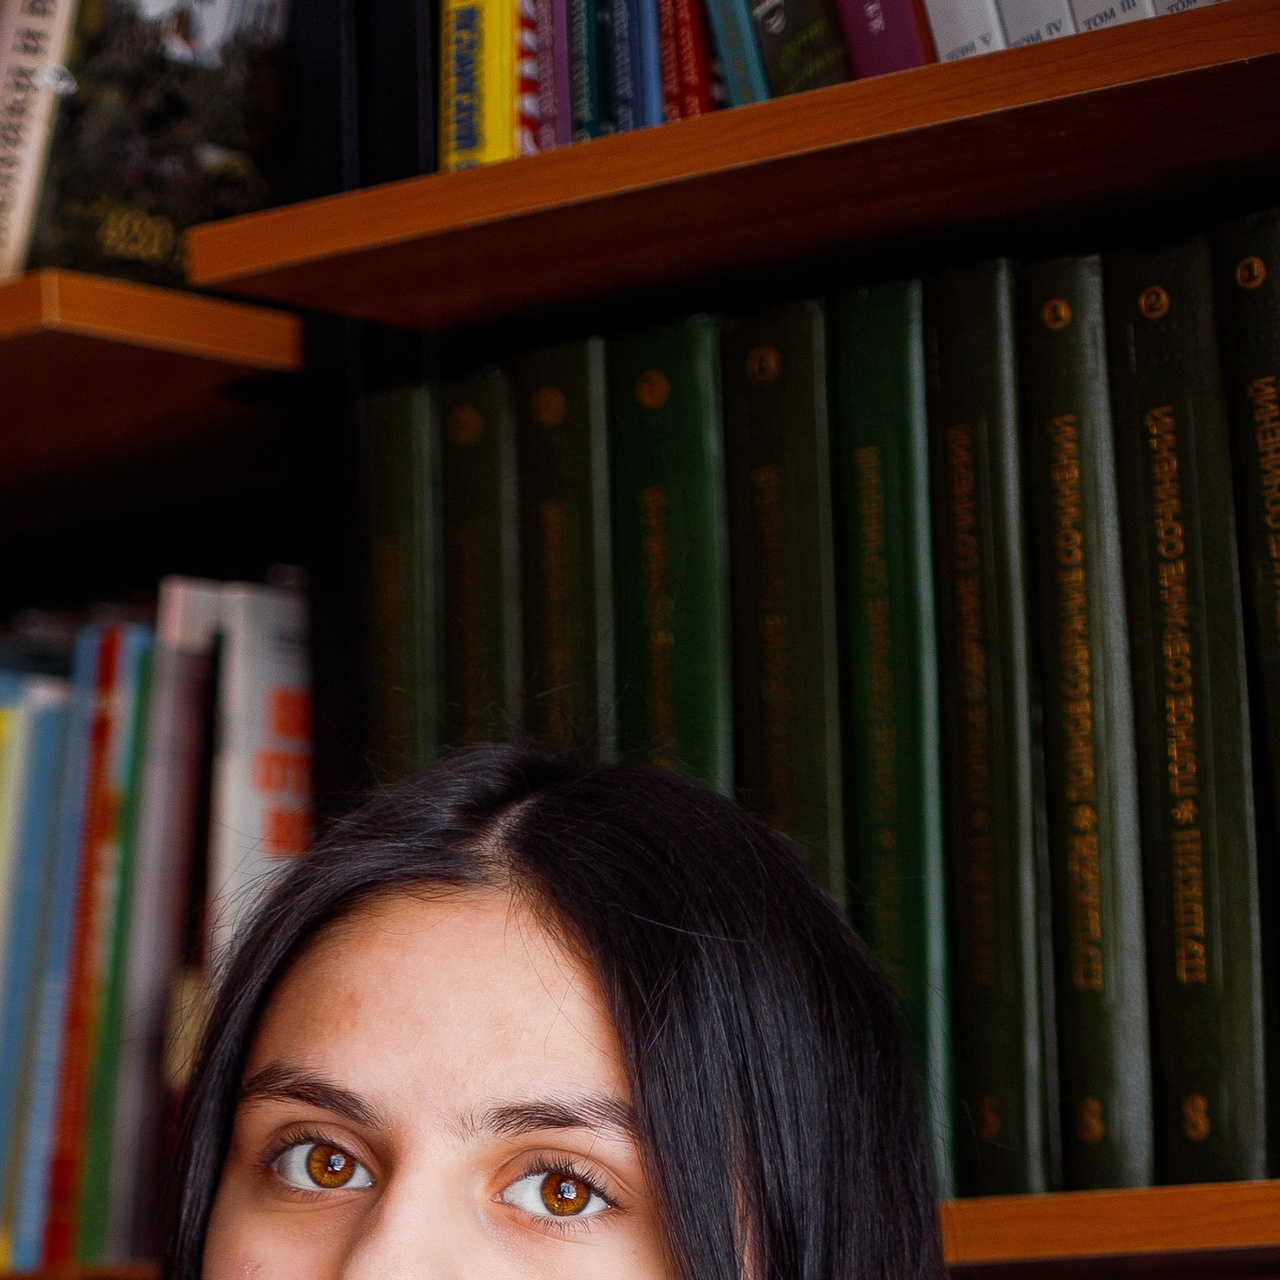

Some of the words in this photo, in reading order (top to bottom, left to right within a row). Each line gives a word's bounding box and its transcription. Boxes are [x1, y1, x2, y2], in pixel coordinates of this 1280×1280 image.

[1044, 17, 1063, 37] IV
[1081, 7, 1117, 31] ТОМ
[1046, 412, 1084, 566] СОЧИНЕНИЙ
[1144, 404, 1186, 559] СОЧИНЕНИЙ
[1057, 566, 1091, 696] СОБРАНИЕ
[1159, 558, 1193, 692] СОБРАНИЕ
[1063, 696, 1095, 802] ПОЛНОЕ
[1166, 691, 1198, 796] ПОЛНОЕ
[1068, 833, 1103, 990] ПУШКИН
[1172, 826, 1206, 985] ПУШКИН
